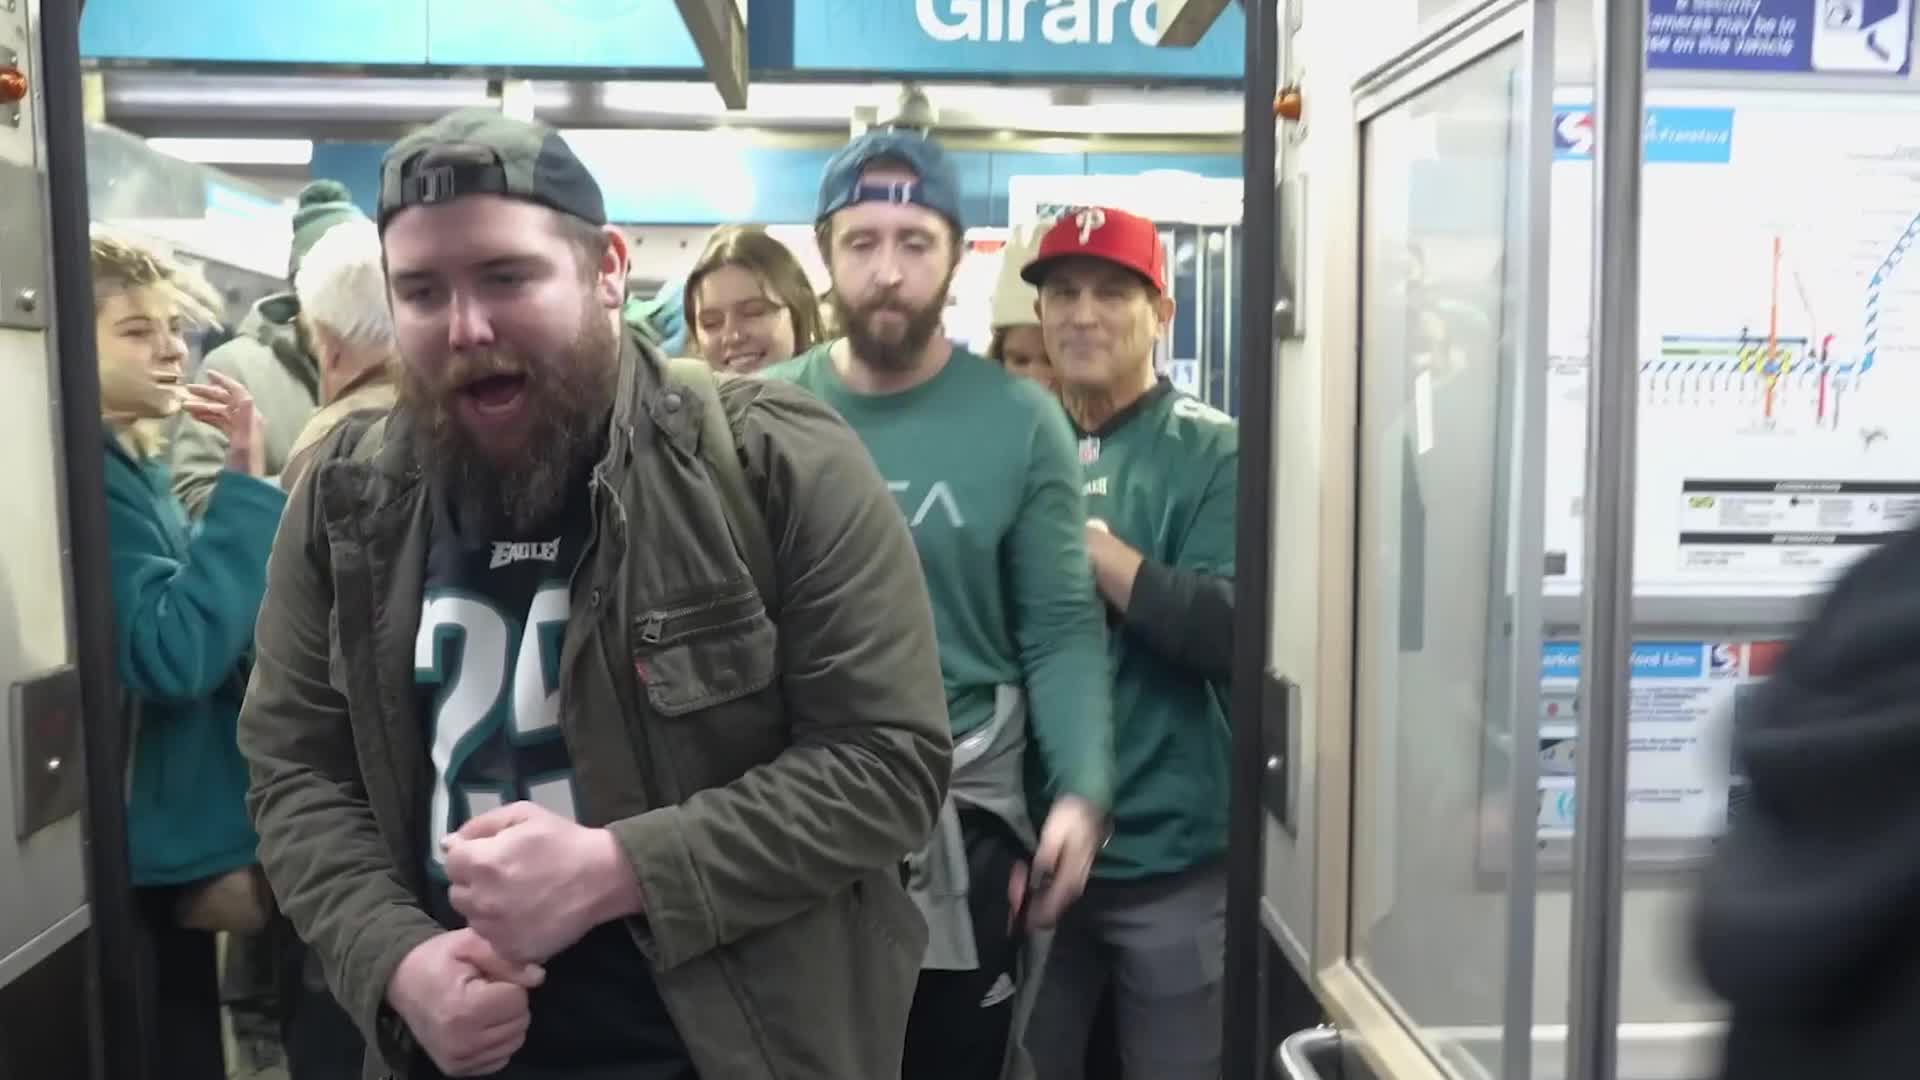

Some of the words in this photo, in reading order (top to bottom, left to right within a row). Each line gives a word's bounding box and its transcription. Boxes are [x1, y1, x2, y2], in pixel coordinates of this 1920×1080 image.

[1714, 15, 1751, 37] may
[1753, 15, 1777, 34] be
[1777, 15, 1797, 35] in
[1672, 37, 1696, 54] on
[1697, 35, 1731, 55] this
[1733, 37, 1794, 57] vehicle
[1076, 207, 1106, 245] P
